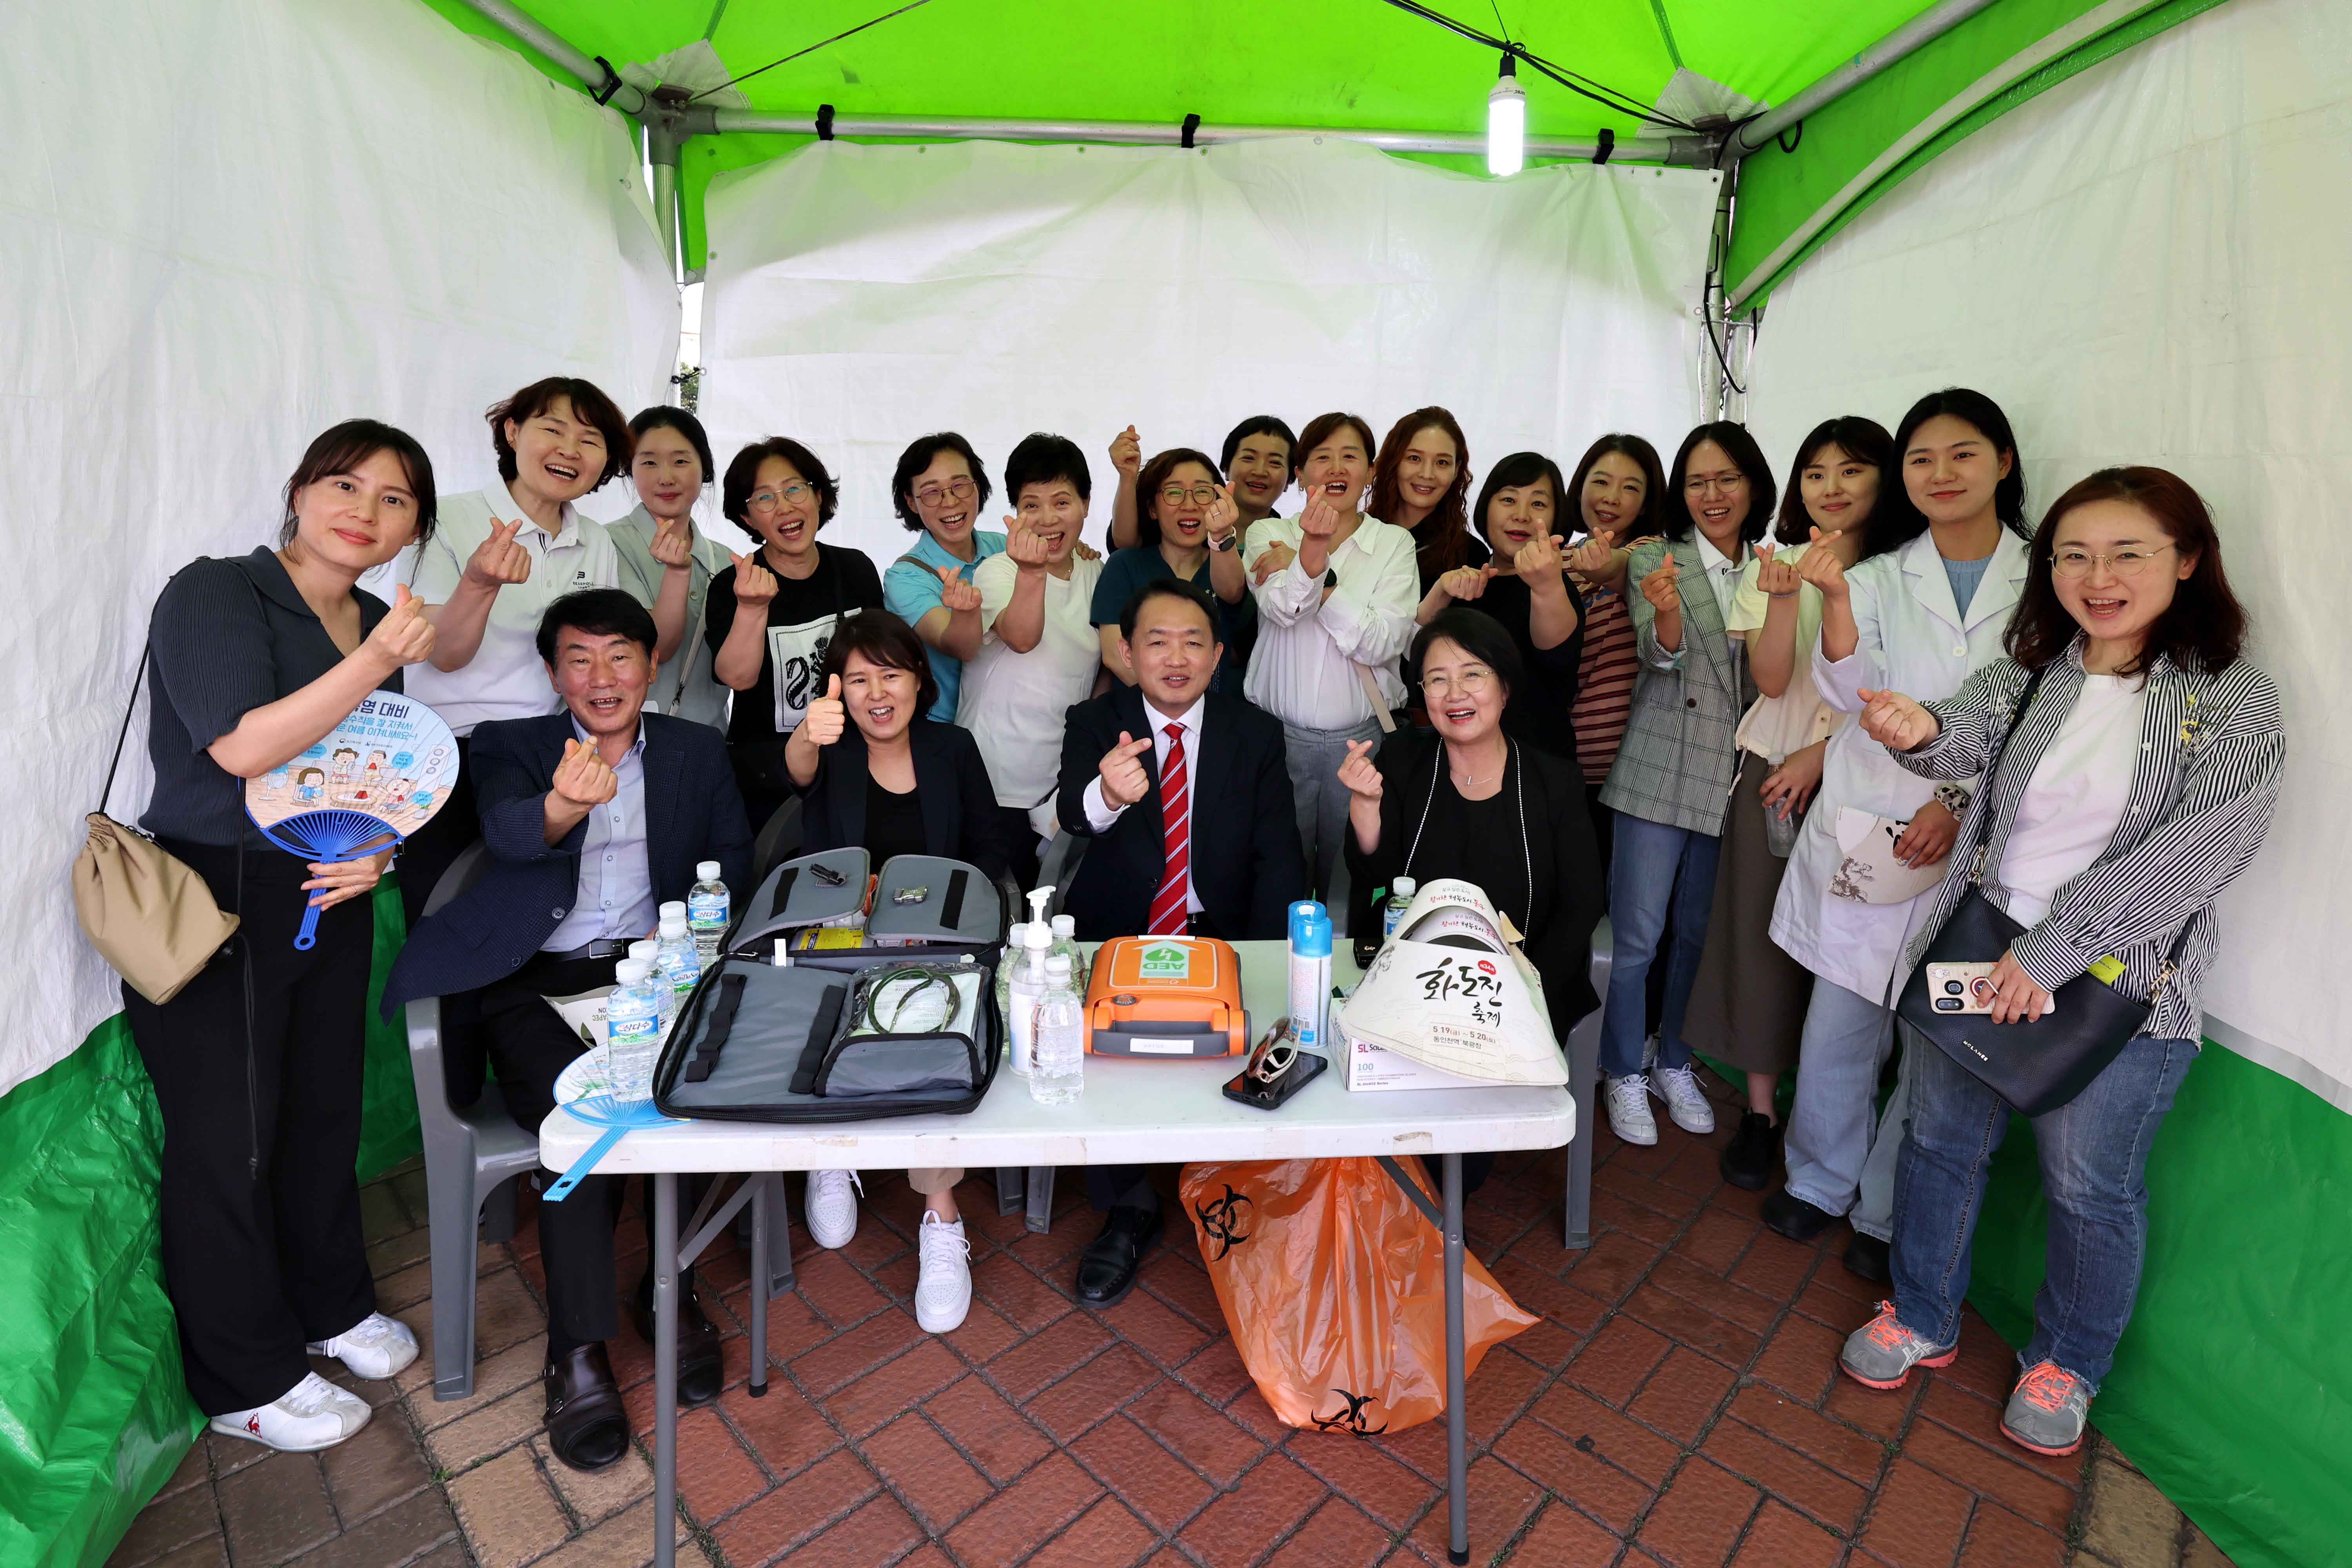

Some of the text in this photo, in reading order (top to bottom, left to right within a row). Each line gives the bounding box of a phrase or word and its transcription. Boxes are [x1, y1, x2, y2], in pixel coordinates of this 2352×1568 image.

[379, 702, 410, 719] 대비
[347, 725, 366, 735] 여름
[376, 719, 386, 728] 잘
[387, 720, 414, 731] 지켜서
[1416, 957, 1503, 1007] 화도진
[1472, 1002, 1501, 1029] 축제
[622, 1021, 650, 1032] 삼다수
[1357, 1044, 1368, 1053] SL
[1433, 1036, 1482, 1049] 동인천역 북광장
